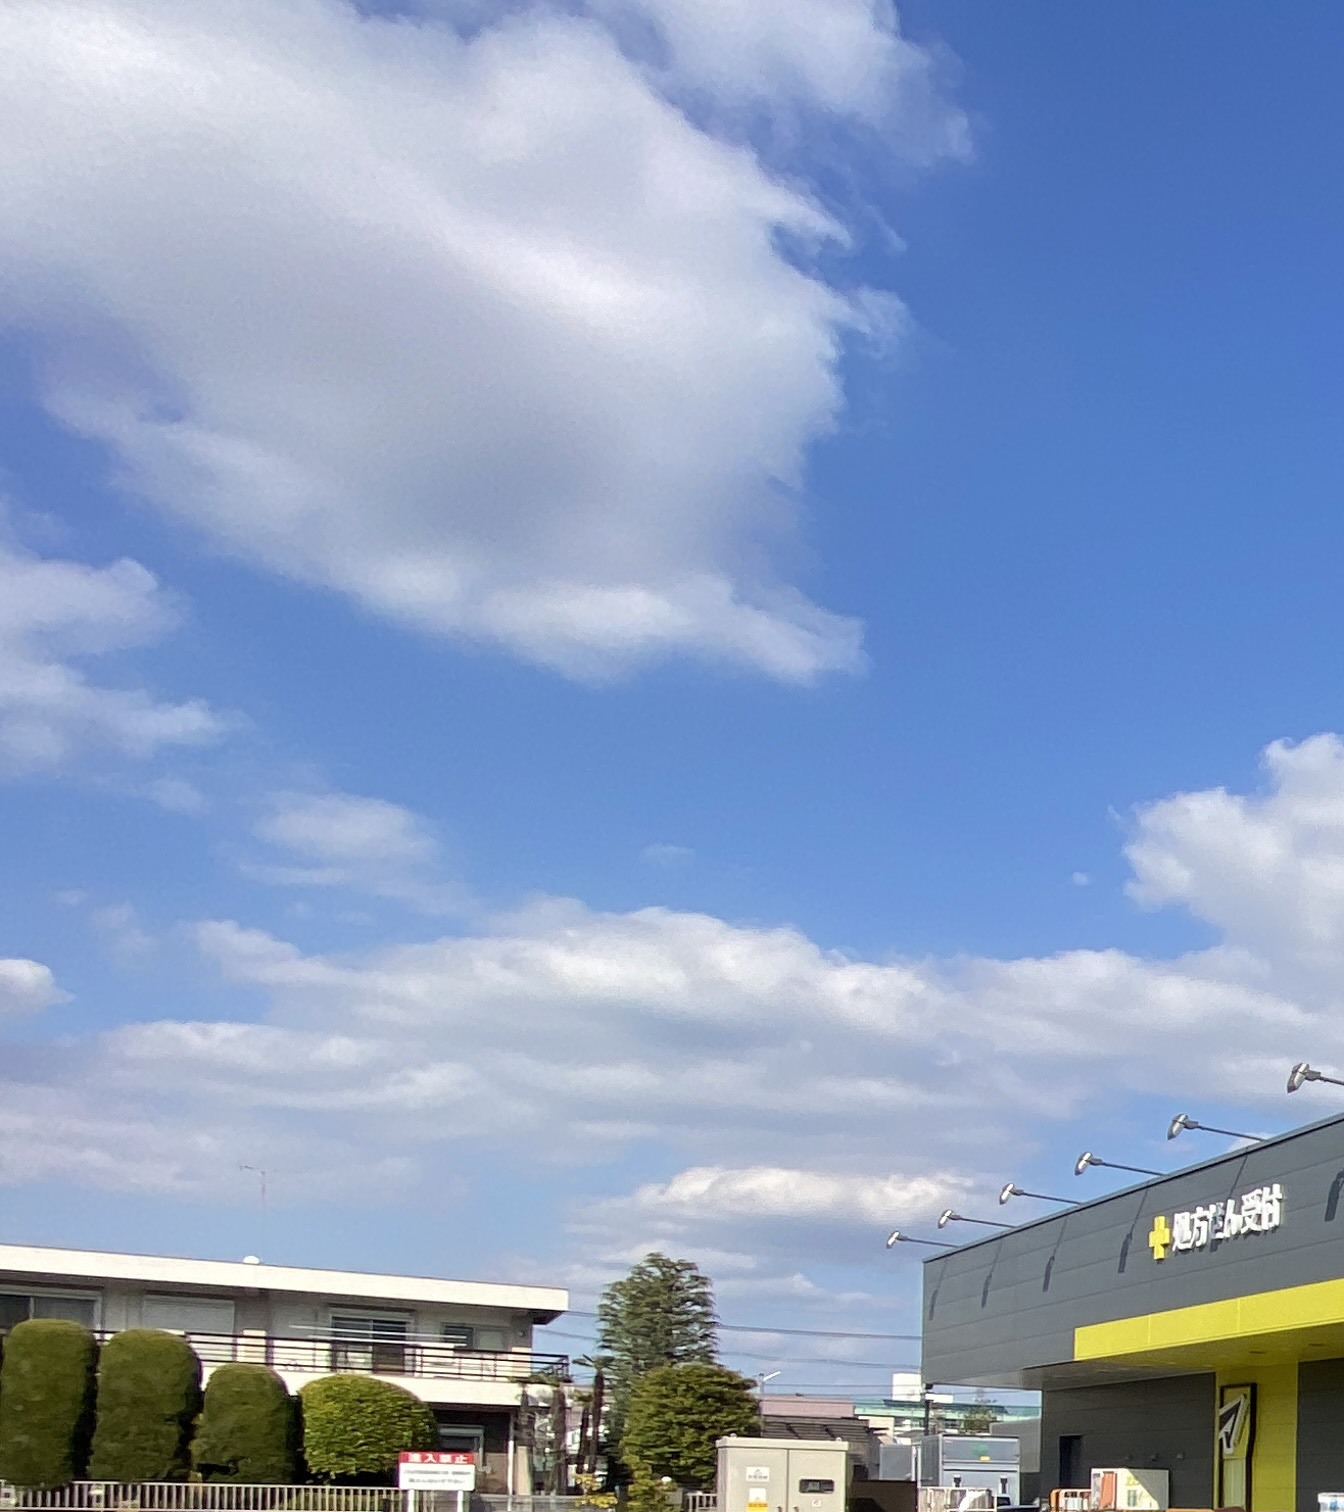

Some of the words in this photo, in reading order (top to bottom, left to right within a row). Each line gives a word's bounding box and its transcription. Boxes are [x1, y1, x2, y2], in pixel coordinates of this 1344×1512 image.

[1172, 1183, 1283, 1252] 処方せん受付
